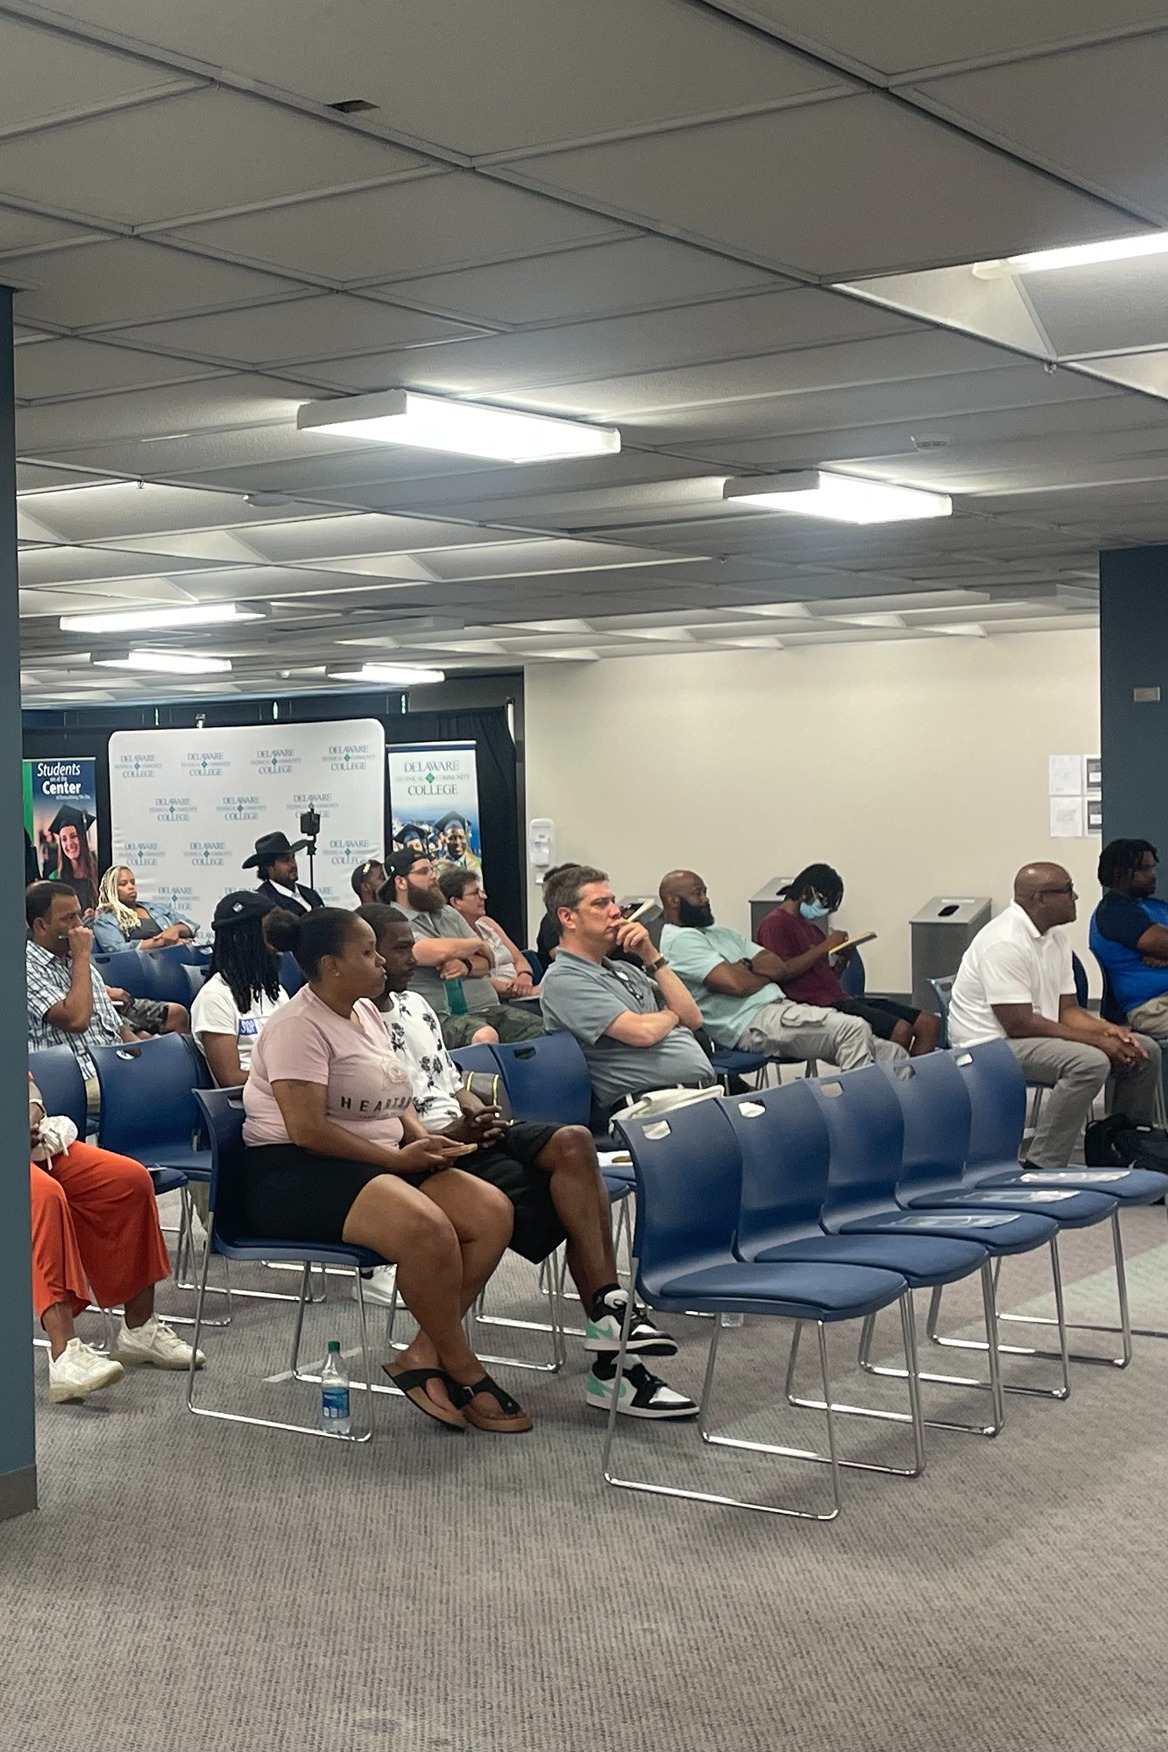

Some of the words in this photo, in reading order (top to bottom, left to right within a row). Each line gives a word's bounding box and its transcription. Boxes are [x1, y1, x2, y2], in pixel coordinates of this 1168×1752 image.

[37, 762, 81, 776] Students
[404, 760, 459, 773] DELAWARE
[42, 780, 82, 795] Center
[407, 784, 458, 796] COLLEGE
